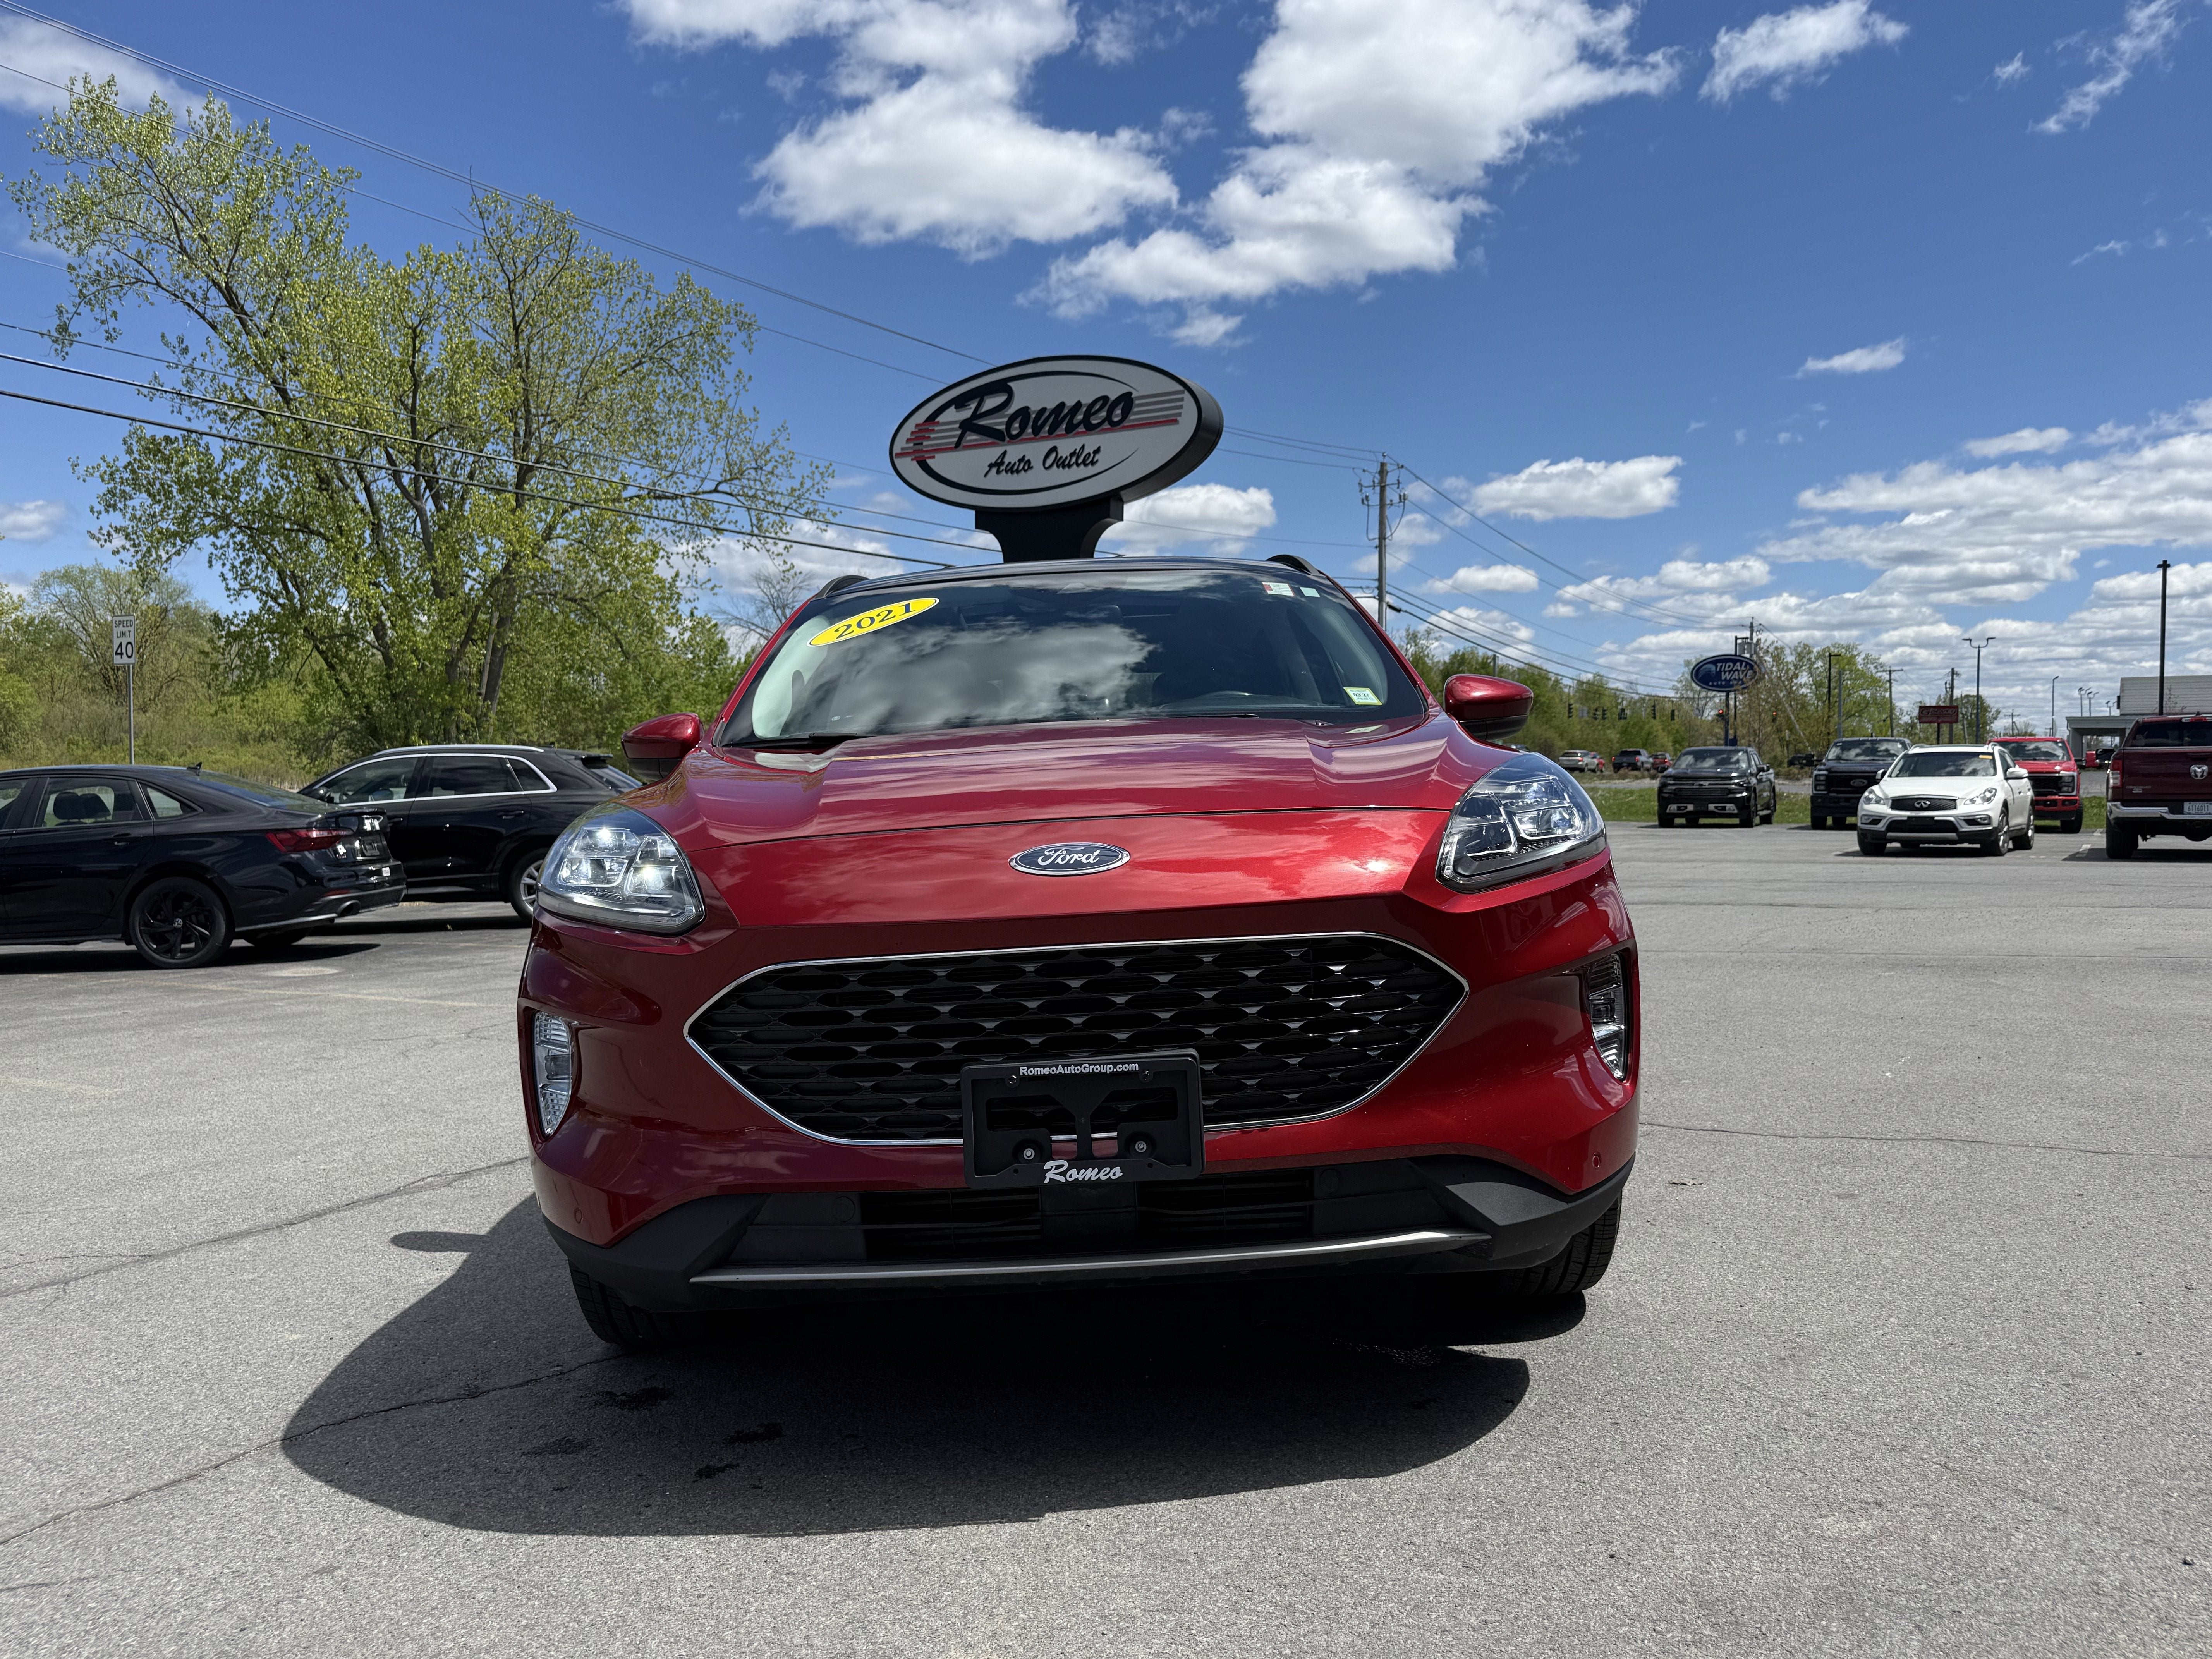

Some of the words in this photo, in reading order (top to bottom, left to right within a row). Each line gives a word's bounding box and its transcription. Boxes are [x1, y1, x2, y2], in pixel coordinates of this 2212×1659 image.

[954, 381, 1134, 448] Romeo
[984, 450, 1033, 477] Auto
[1042, 443, 1101, 470] Outlet
[114, 620, 133, 628] SPEED
[834, 603, 916, 639] 2021
[117, 630, 131, 638] LIMIT
[115, 641, 134, 659] 40
[1716, 661, 1746, 672] TIDAL
[1721, 670, 1753, 680] WAVE
[1037, 847, 1100, 866] Ford
[1020, 1063, 1139, 1076] RomeoAutoGroup.com
[1044, 1160, 1123, 1184] Romeo
